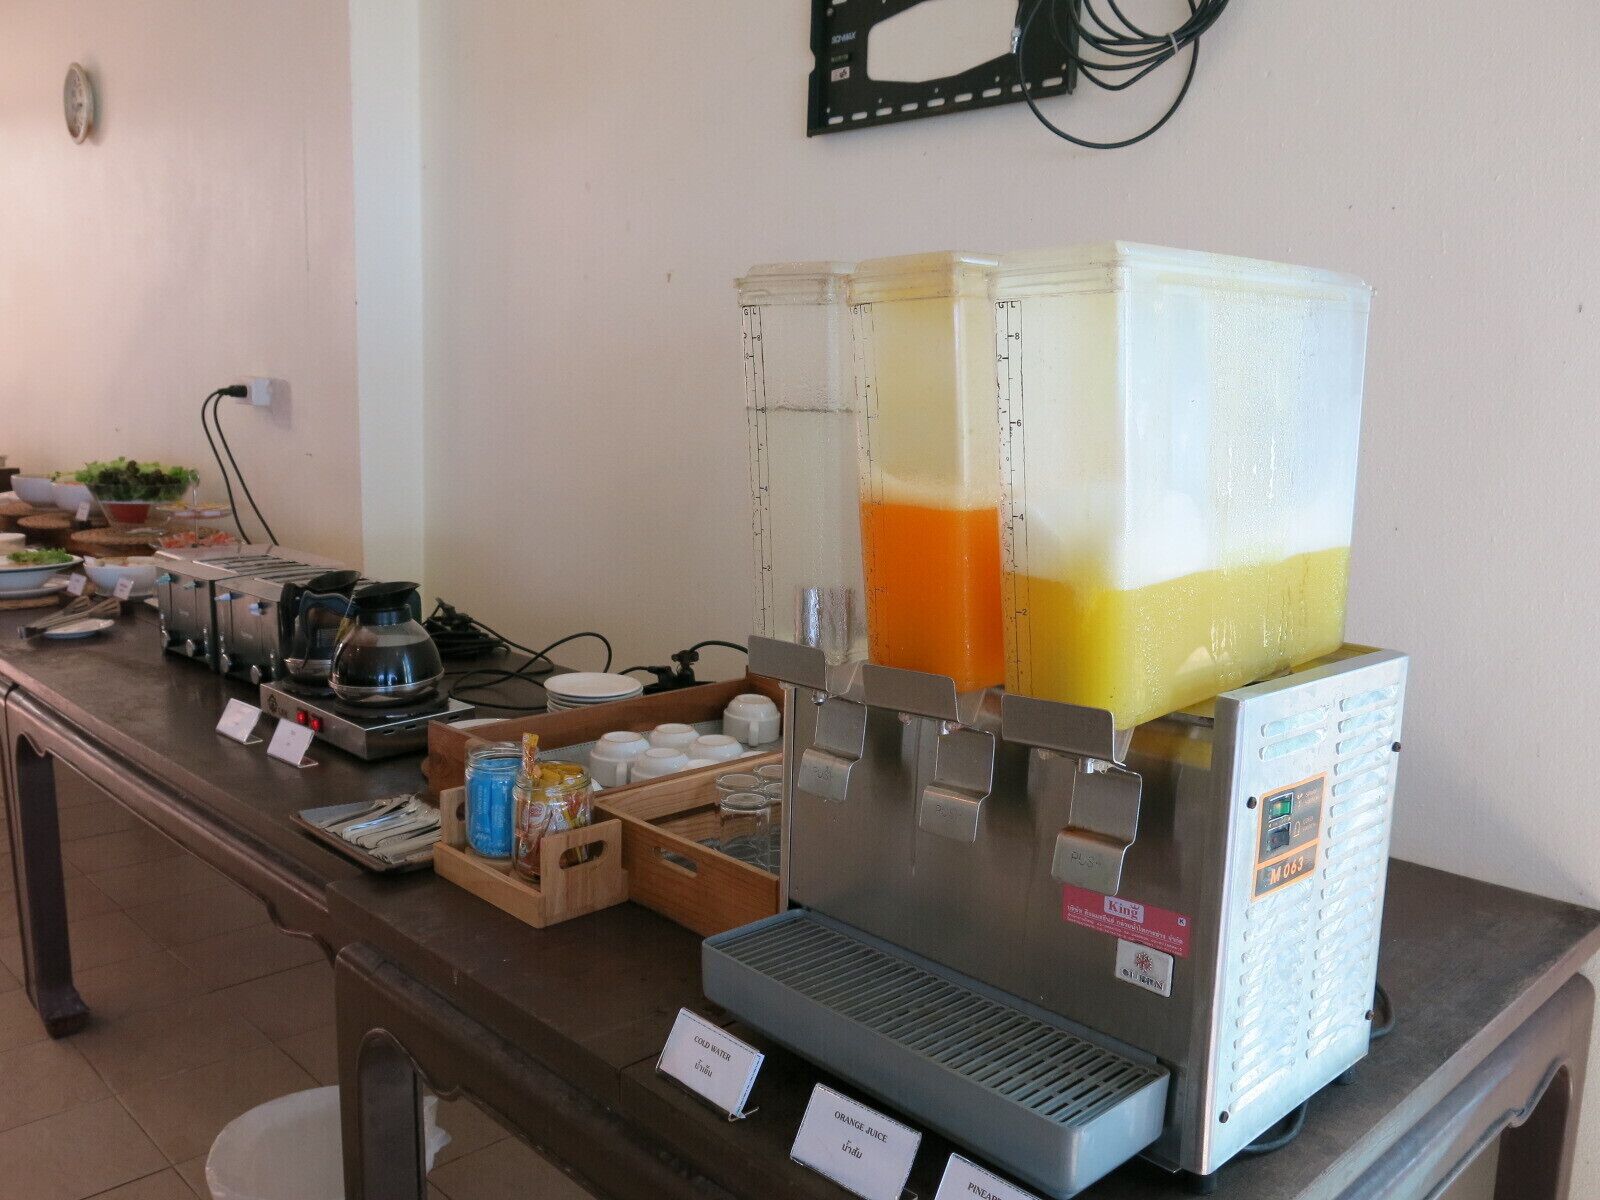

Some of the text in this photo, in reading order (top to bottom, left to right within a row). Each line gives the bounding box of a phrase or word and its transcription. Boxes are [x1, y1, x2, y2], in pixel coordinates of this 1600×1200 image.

[743, 307, 757, 316] G L
[1014, 332, 1020, 340] 8
[1016, 419, 1022, 427] 6
[1018, 513, 1024, 521] 4
[1021, 608, 1027, 616] 2
[1109, 900, 1138, 920] King
[693, 1035, 731, 1061] COLD WATER
[834, 1110, 888, 1143] ORANGE JUICE
[841, 1140, 863, 1159] น้ำส้ม
